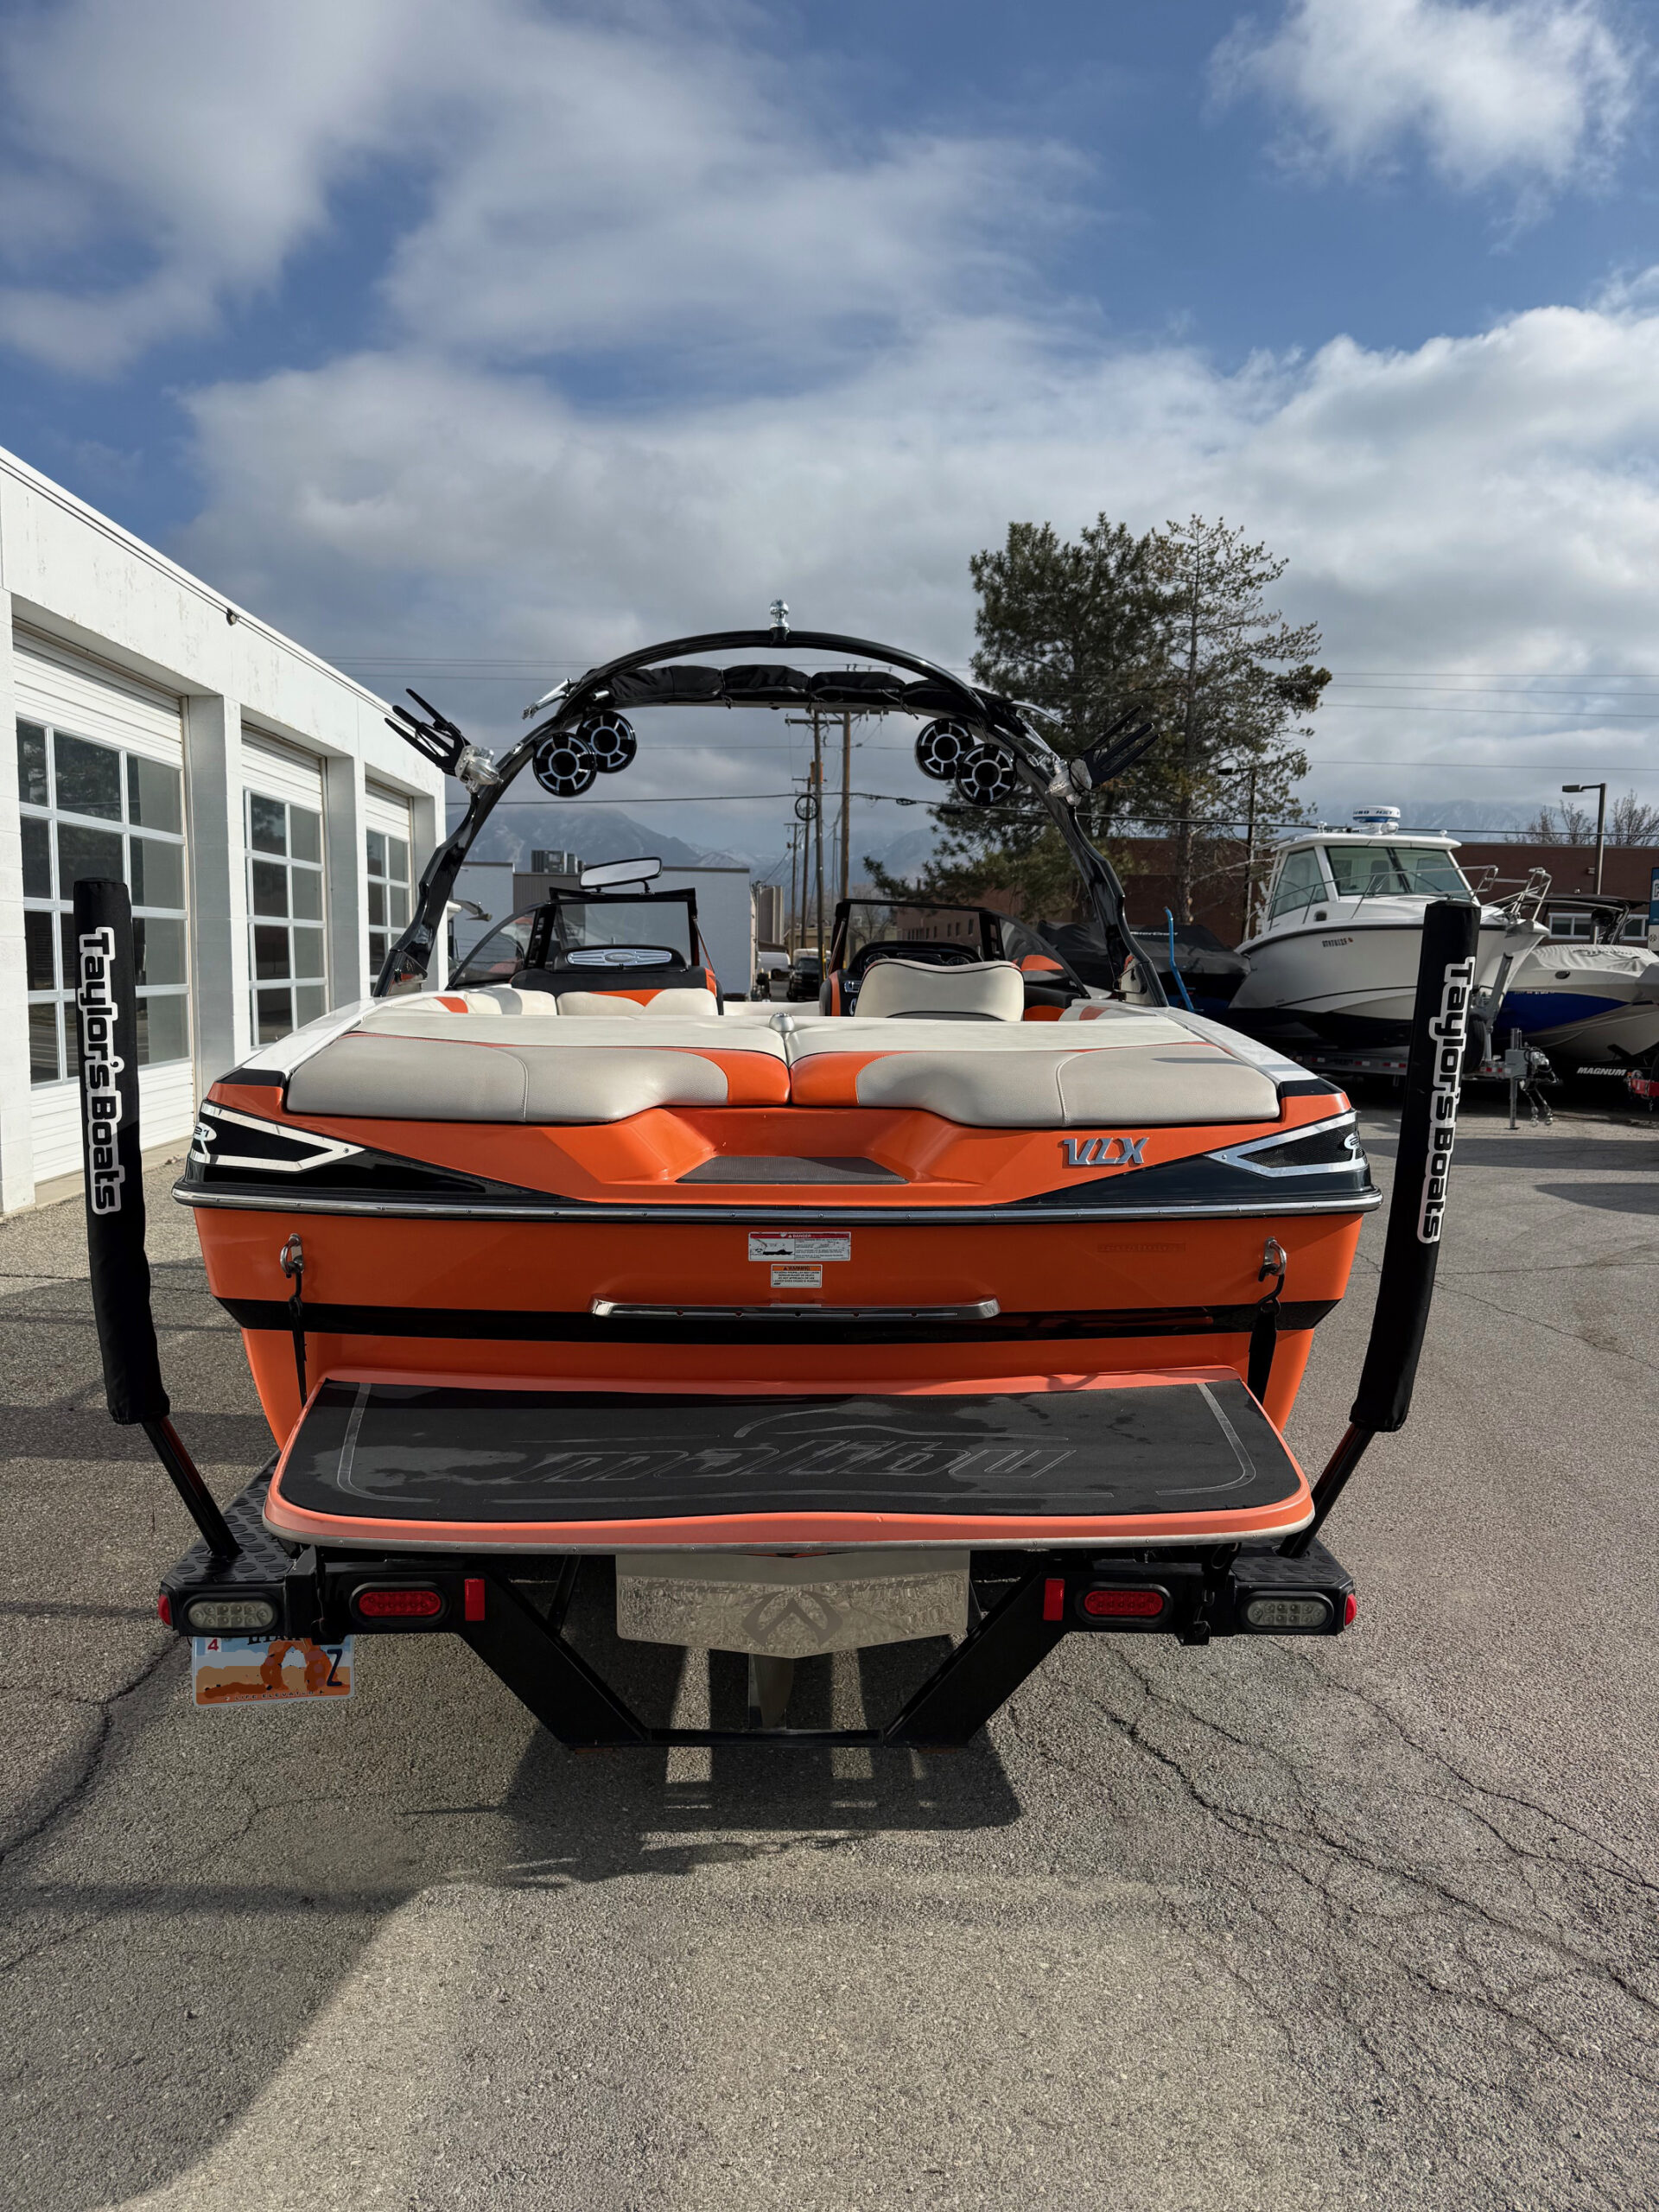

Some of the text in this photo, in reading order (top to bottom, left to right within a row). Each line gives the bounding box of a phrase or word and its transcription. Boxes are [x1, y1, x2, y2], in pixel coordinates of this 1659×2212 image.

[79, 930, 121, 1211] Taylor's Boats
[1576, 1066, 1627, 1077] MAGNUM
[1421, 960, 1474, 1240] Taylor's Boats
[1063, 1136, 1151, 1166] VLX
[327, 1649, 342, 1687] Z
